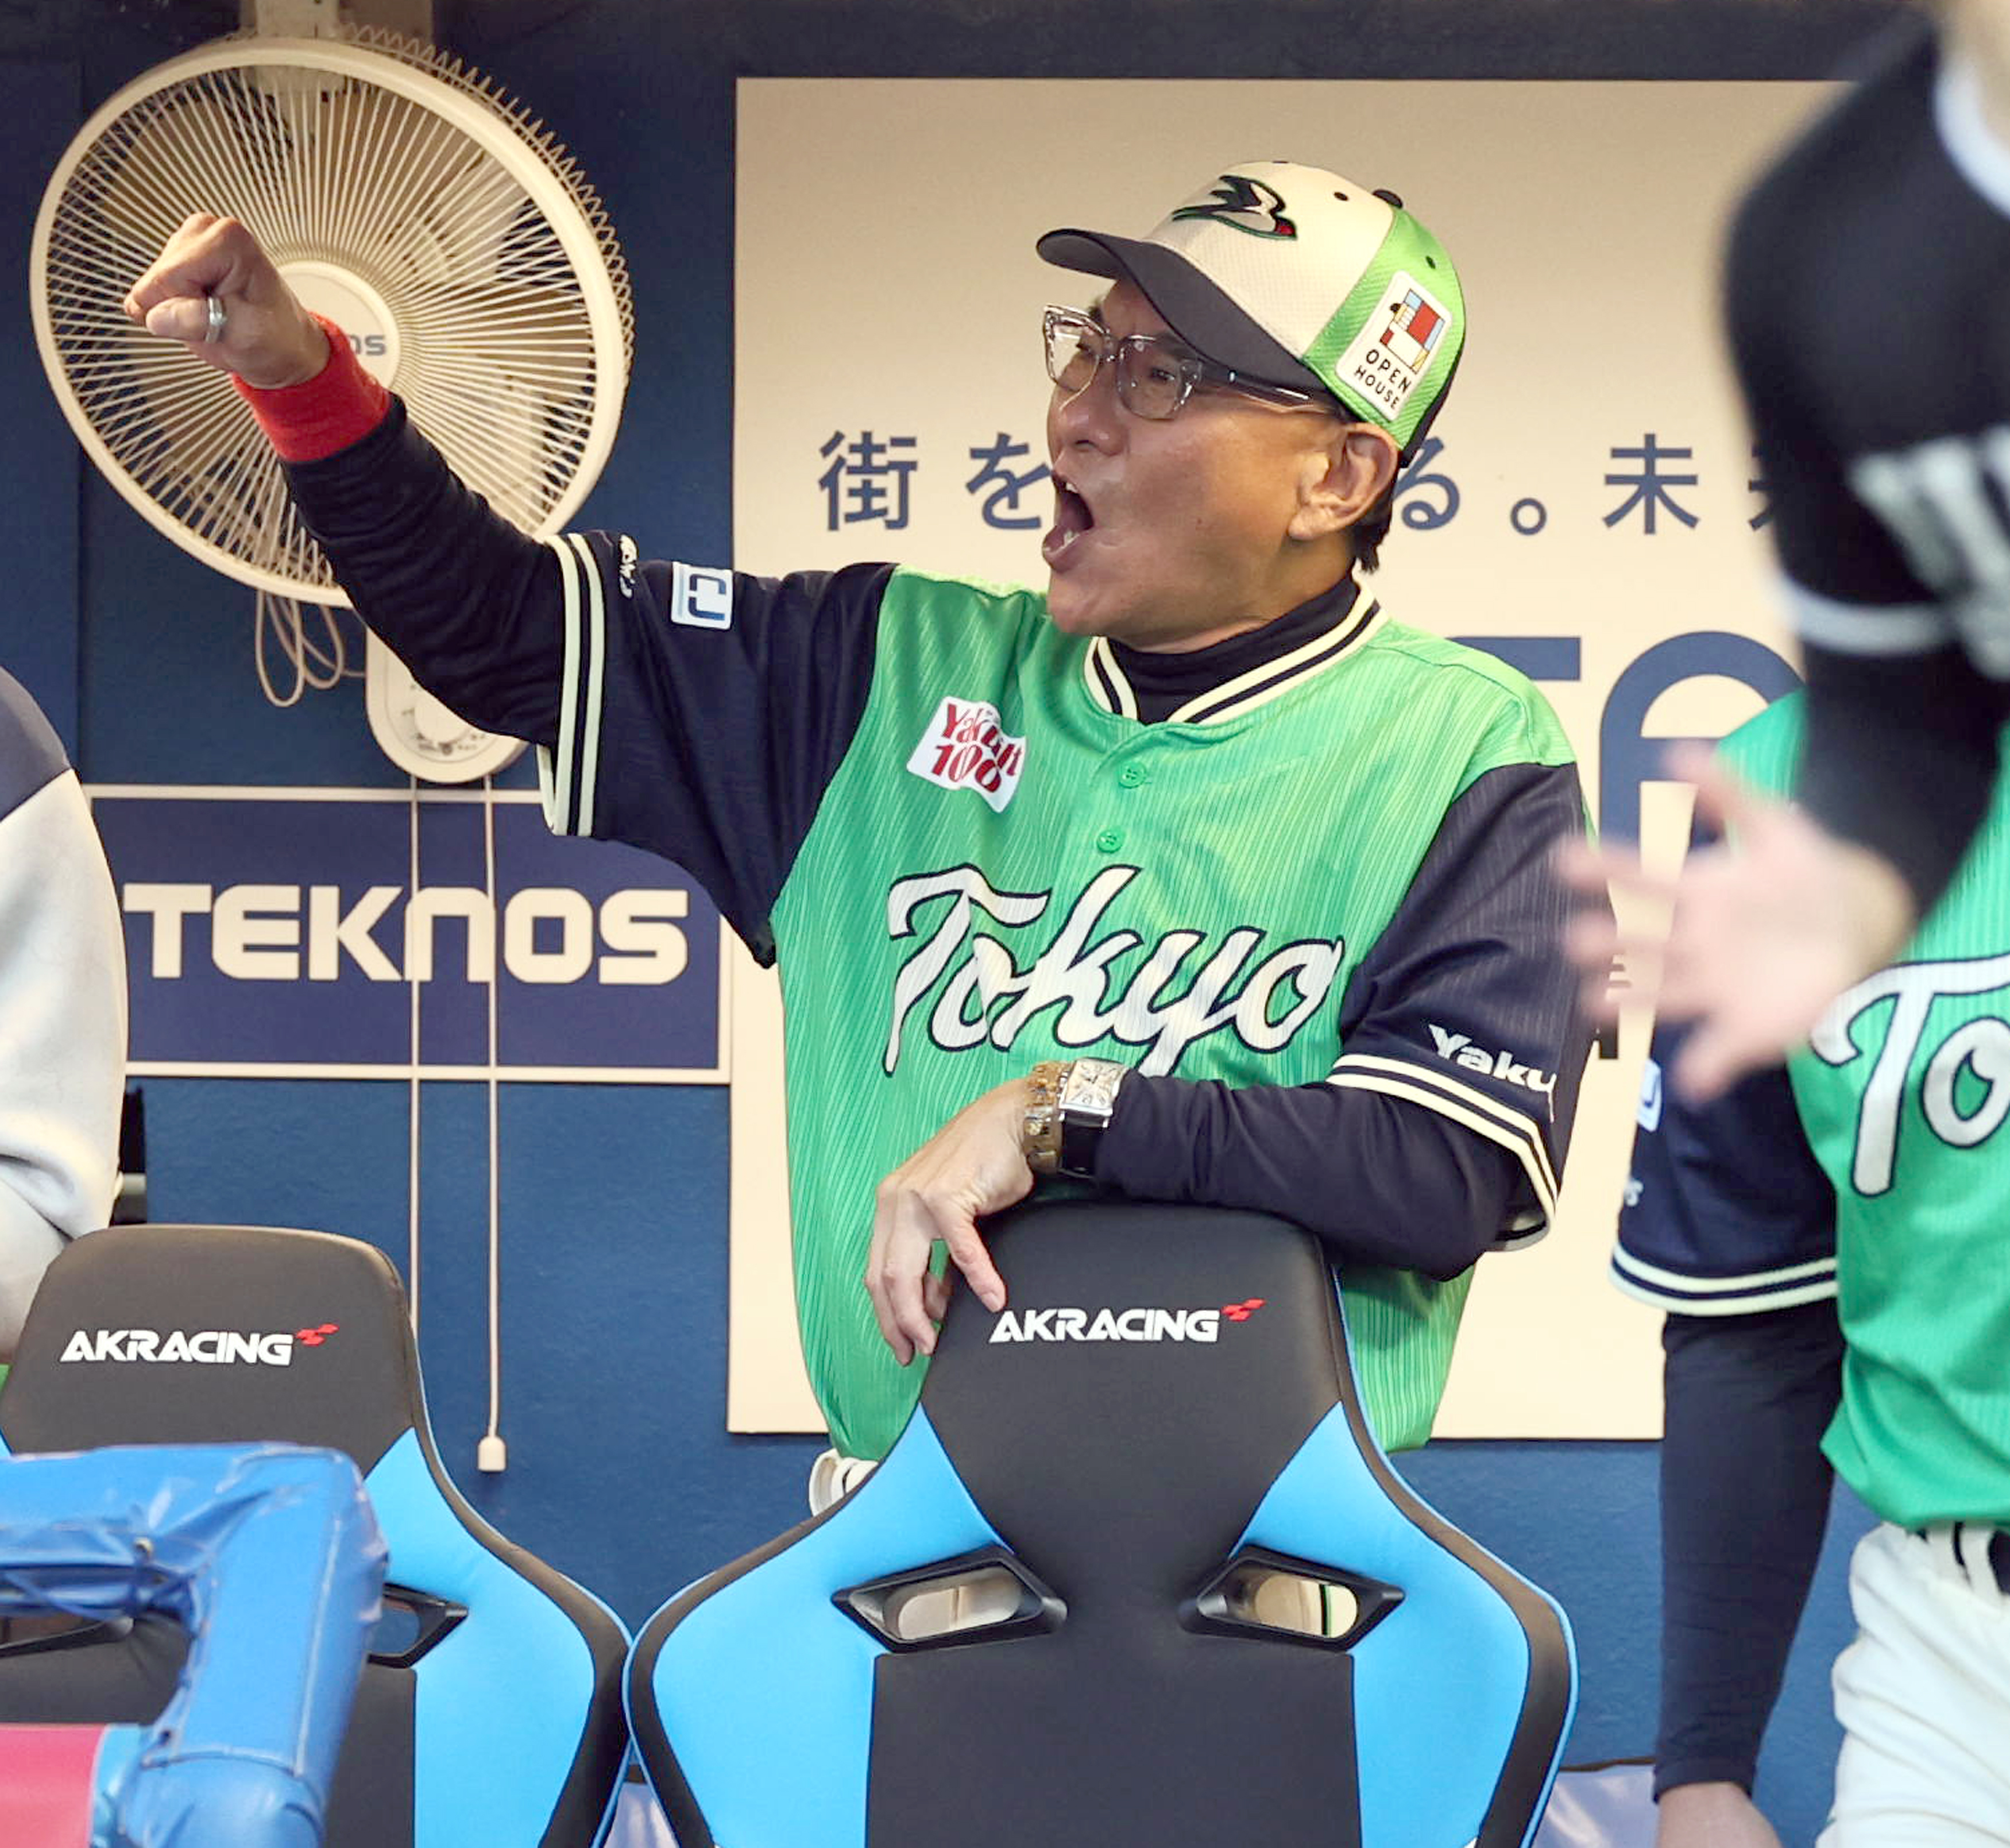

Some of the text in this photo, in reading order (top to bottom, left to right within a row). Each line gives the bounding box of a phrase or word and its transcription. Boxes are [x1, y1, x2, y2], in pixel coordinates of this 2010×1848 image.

[1354, 365, 1400, 410] HOUSE
[1366, 349, 1412, 394] OPEN
[122, 883, 689, 985] TEKNOS
[883, 863, 1346, 1077] Tokyo
[59, 1330, 294, 1366] AKRACING
[988, 1308, 1221, 1343] AKRACING
